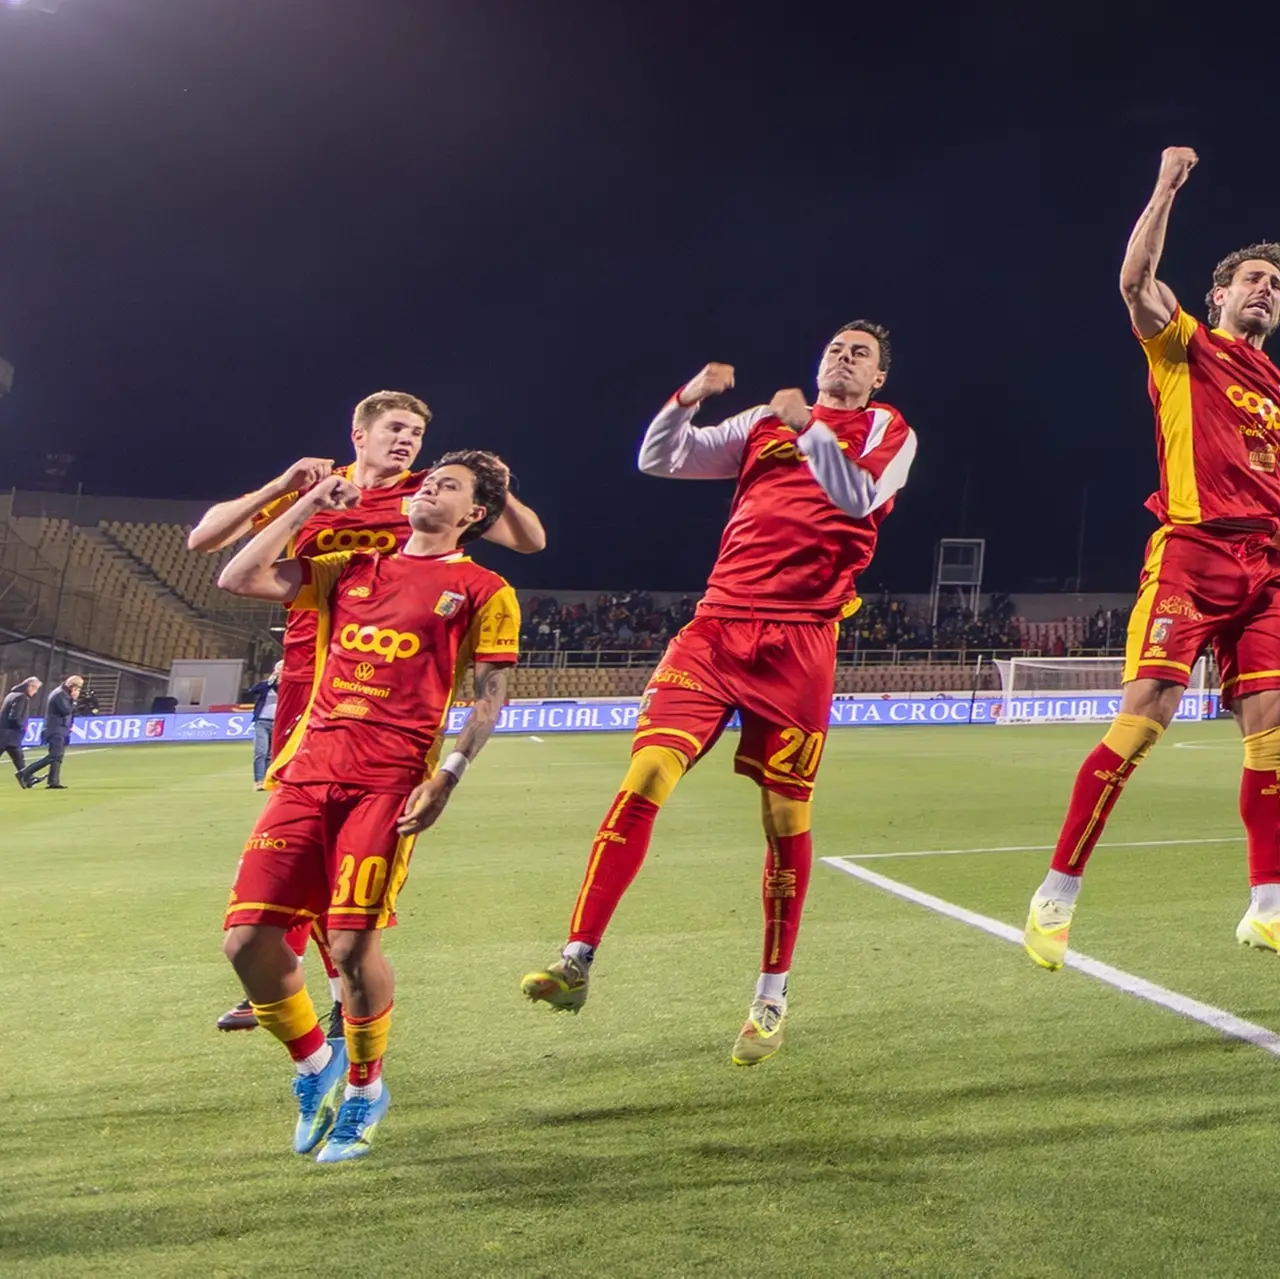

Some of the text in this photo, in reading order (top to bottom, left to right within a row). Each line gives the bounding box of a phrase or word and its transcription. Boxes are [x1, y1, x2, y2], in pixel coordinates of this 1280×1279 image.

[340, 623, 420, 663] coop
[332, 676, 391, 698] Bencivenni
[889, 700, 987, 721] CROCE
[768, 727, 824, 778] 20
[331, 854, 388, 907] 30
